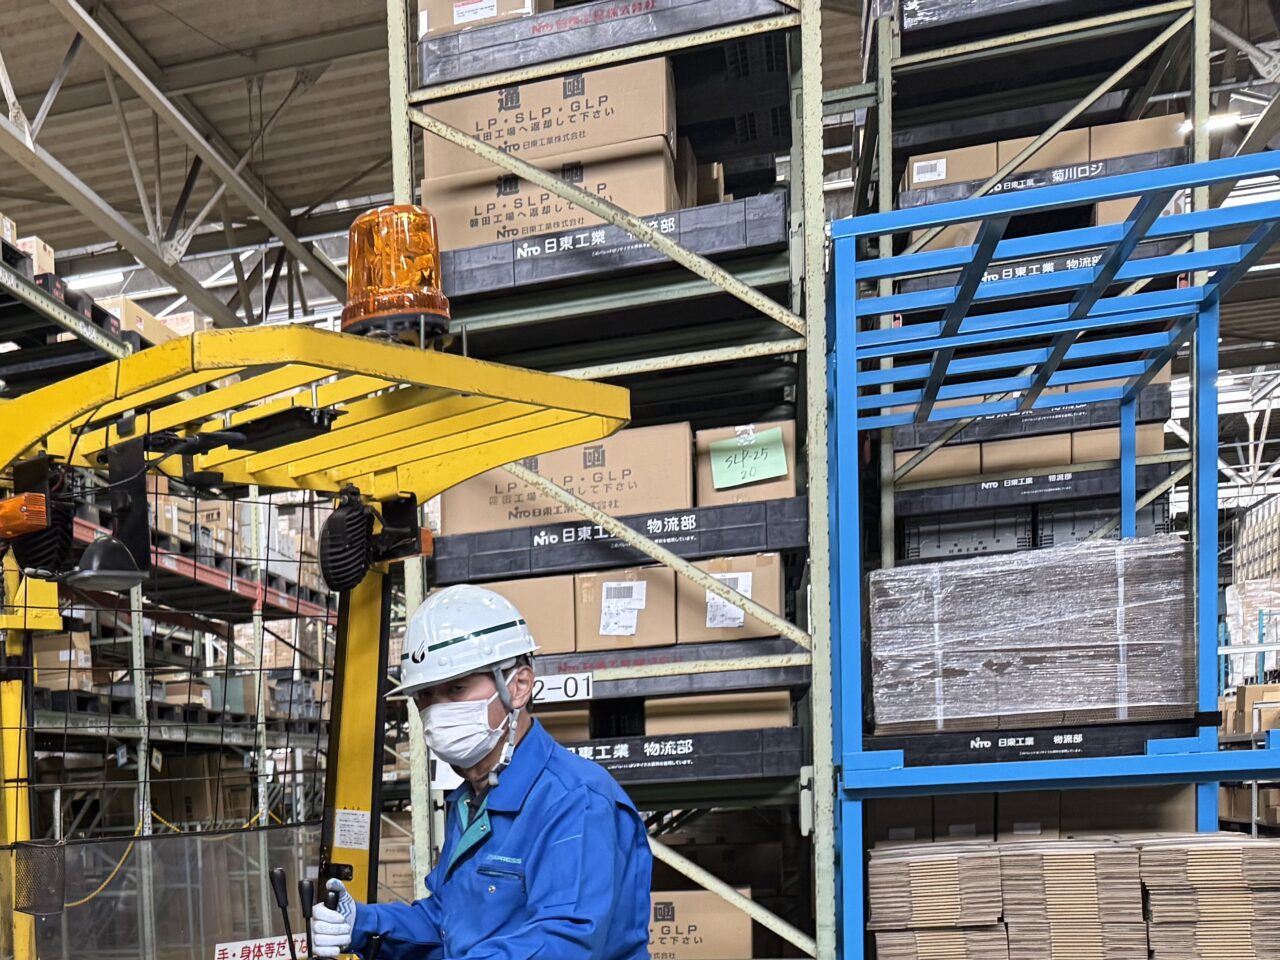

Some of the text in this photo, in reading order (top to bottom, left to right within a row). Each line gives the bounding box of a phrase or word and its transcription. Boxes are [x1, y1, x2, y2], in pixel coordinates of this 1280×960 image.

[1052, 163, 1103, 182] 菊川ロジ
[545, 230, 606, 253] 日東工業
[1002, 262, 1054, 277] 日東工業
[646, 515, 696, 534] 物流部
[644, 739, 693, 757] 物流部
